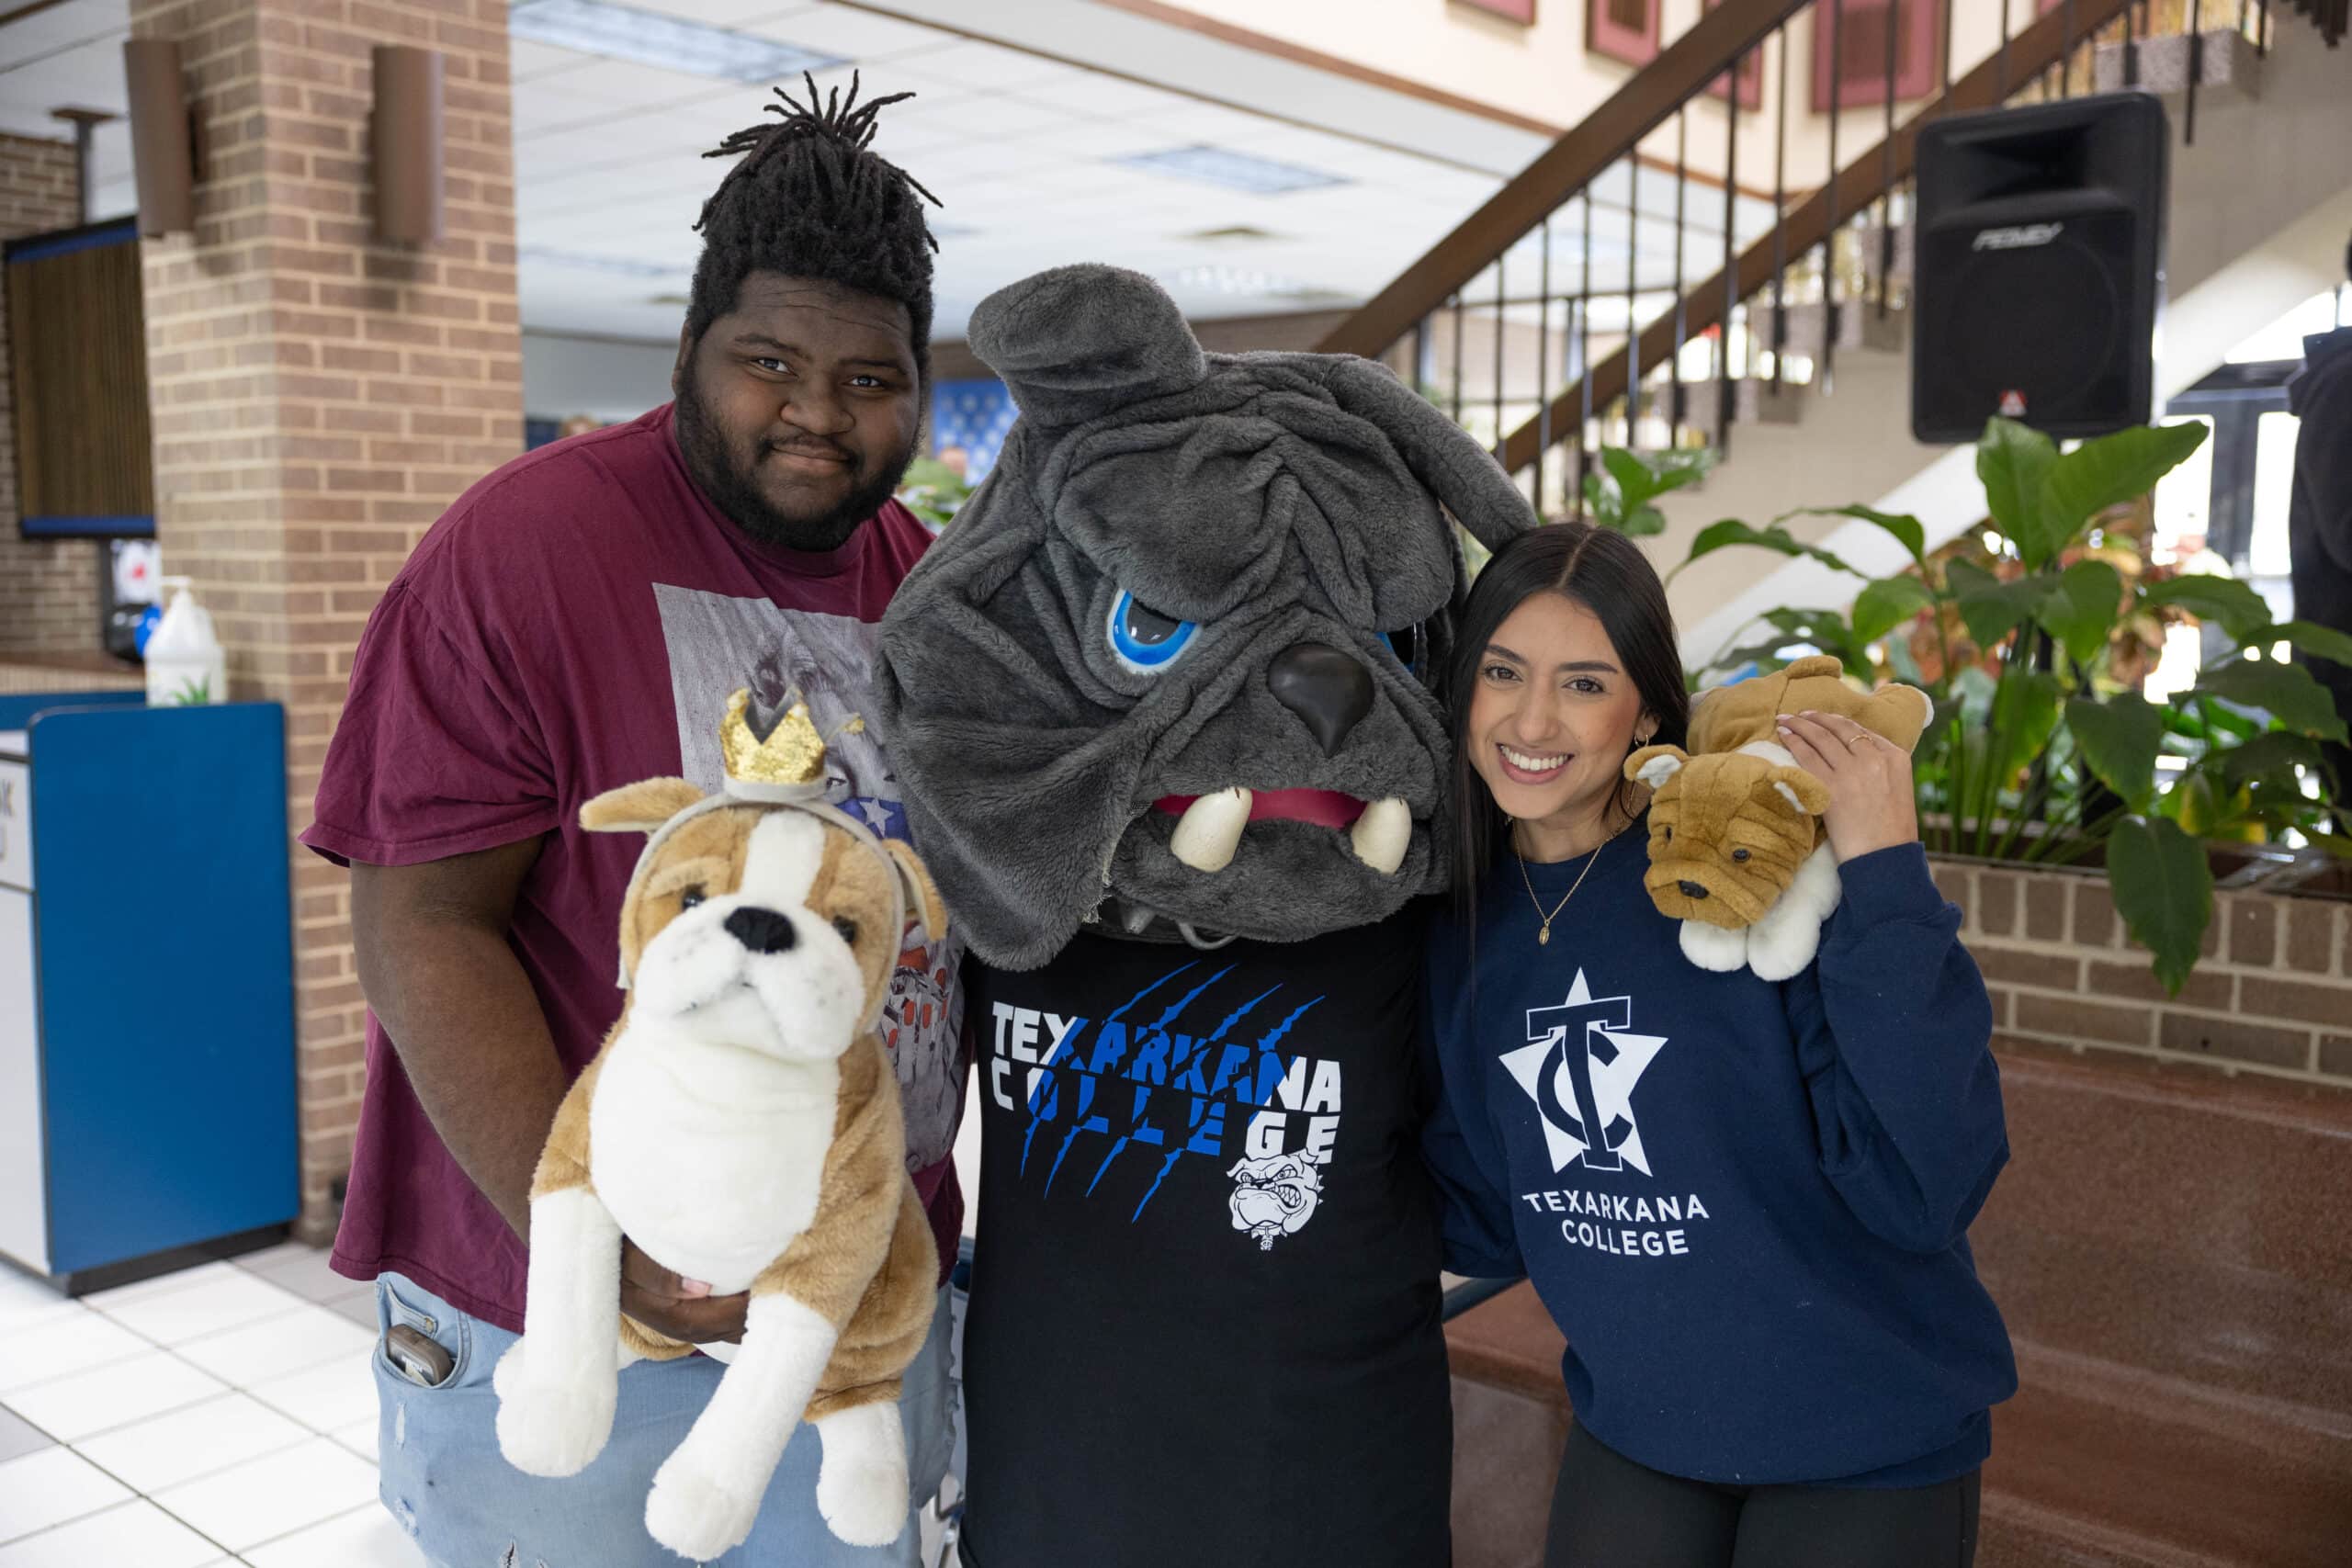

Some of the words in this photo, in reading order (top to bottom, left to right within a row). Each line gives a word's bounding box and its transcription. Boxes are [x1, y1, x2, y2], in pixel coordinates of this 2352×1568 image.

[992, 1000, 1341, 1112] TEXARKANA
[1521, 1190, 1710, 1223] TEXARKANA
[1561, 1219, 1690, 1257] COLLEGE
